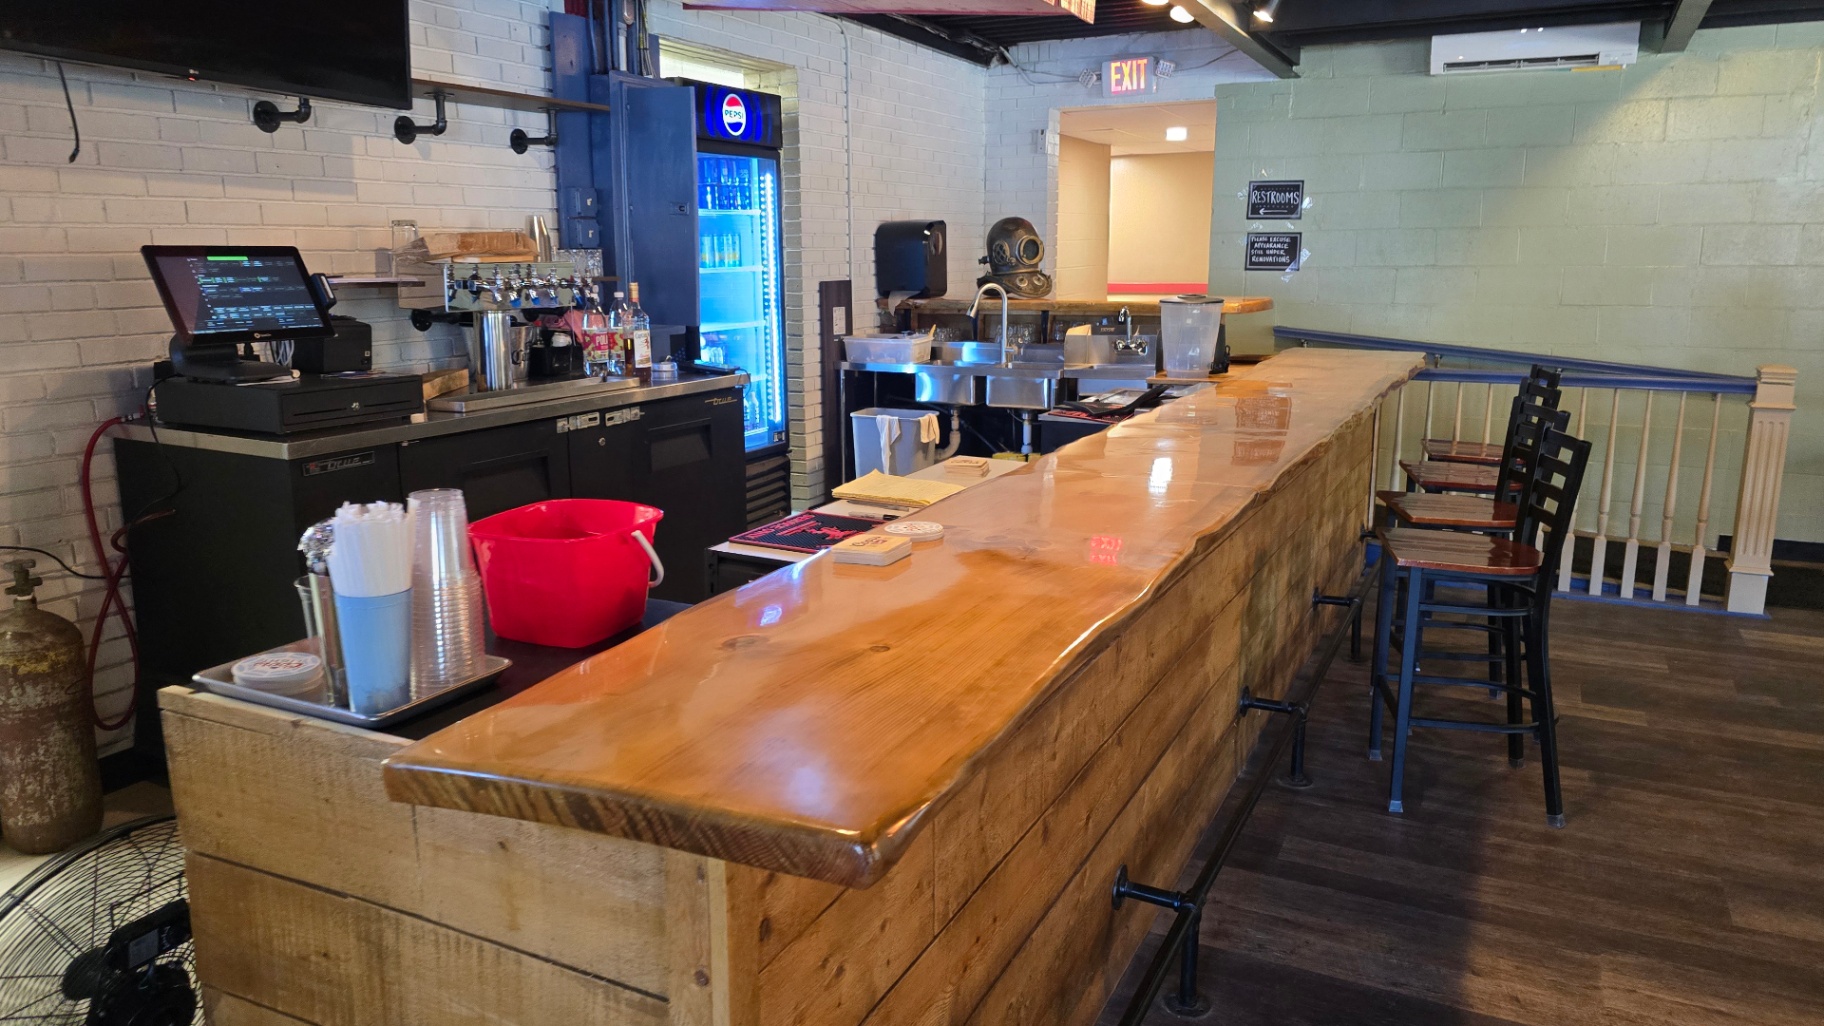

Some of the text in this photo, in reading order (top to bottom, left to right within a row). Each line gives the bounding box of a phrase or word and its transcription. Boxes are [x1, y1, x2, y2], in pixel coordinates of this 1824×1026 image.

[1110, 58, 1148, 92] EXIT
[724, 109, 744, 119] PEPSI
[1251, 190, 1300, 204] RESTROOMS
[1251, 256, 1291, 264] RENOVATIONS
